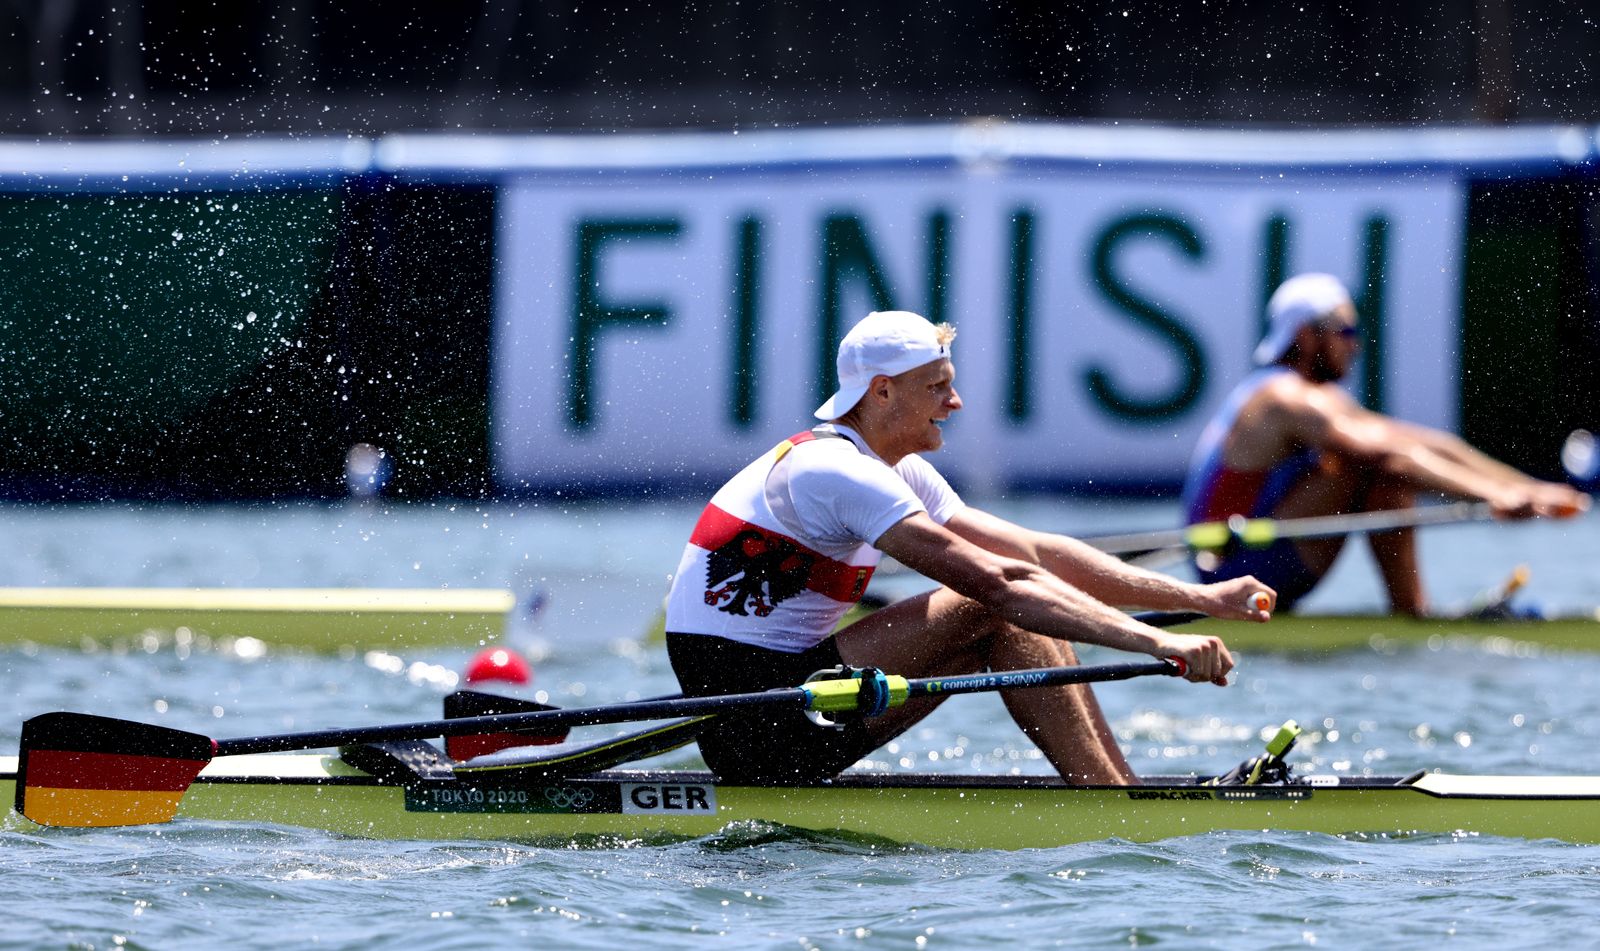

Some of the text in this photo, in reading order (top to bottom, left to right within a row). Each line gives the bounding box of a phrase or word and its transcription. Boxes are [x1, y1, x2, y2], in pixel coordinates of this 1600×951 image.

[566, 207, 1393, 432] FINISH
[943, 673, 1046, 690] concept 2 SKINNY
[431, 789, 526, 803] TOKYO 2020
[630, 785, 710, 810] GER
[1127, 791, 1213, 800] EMPACHER
